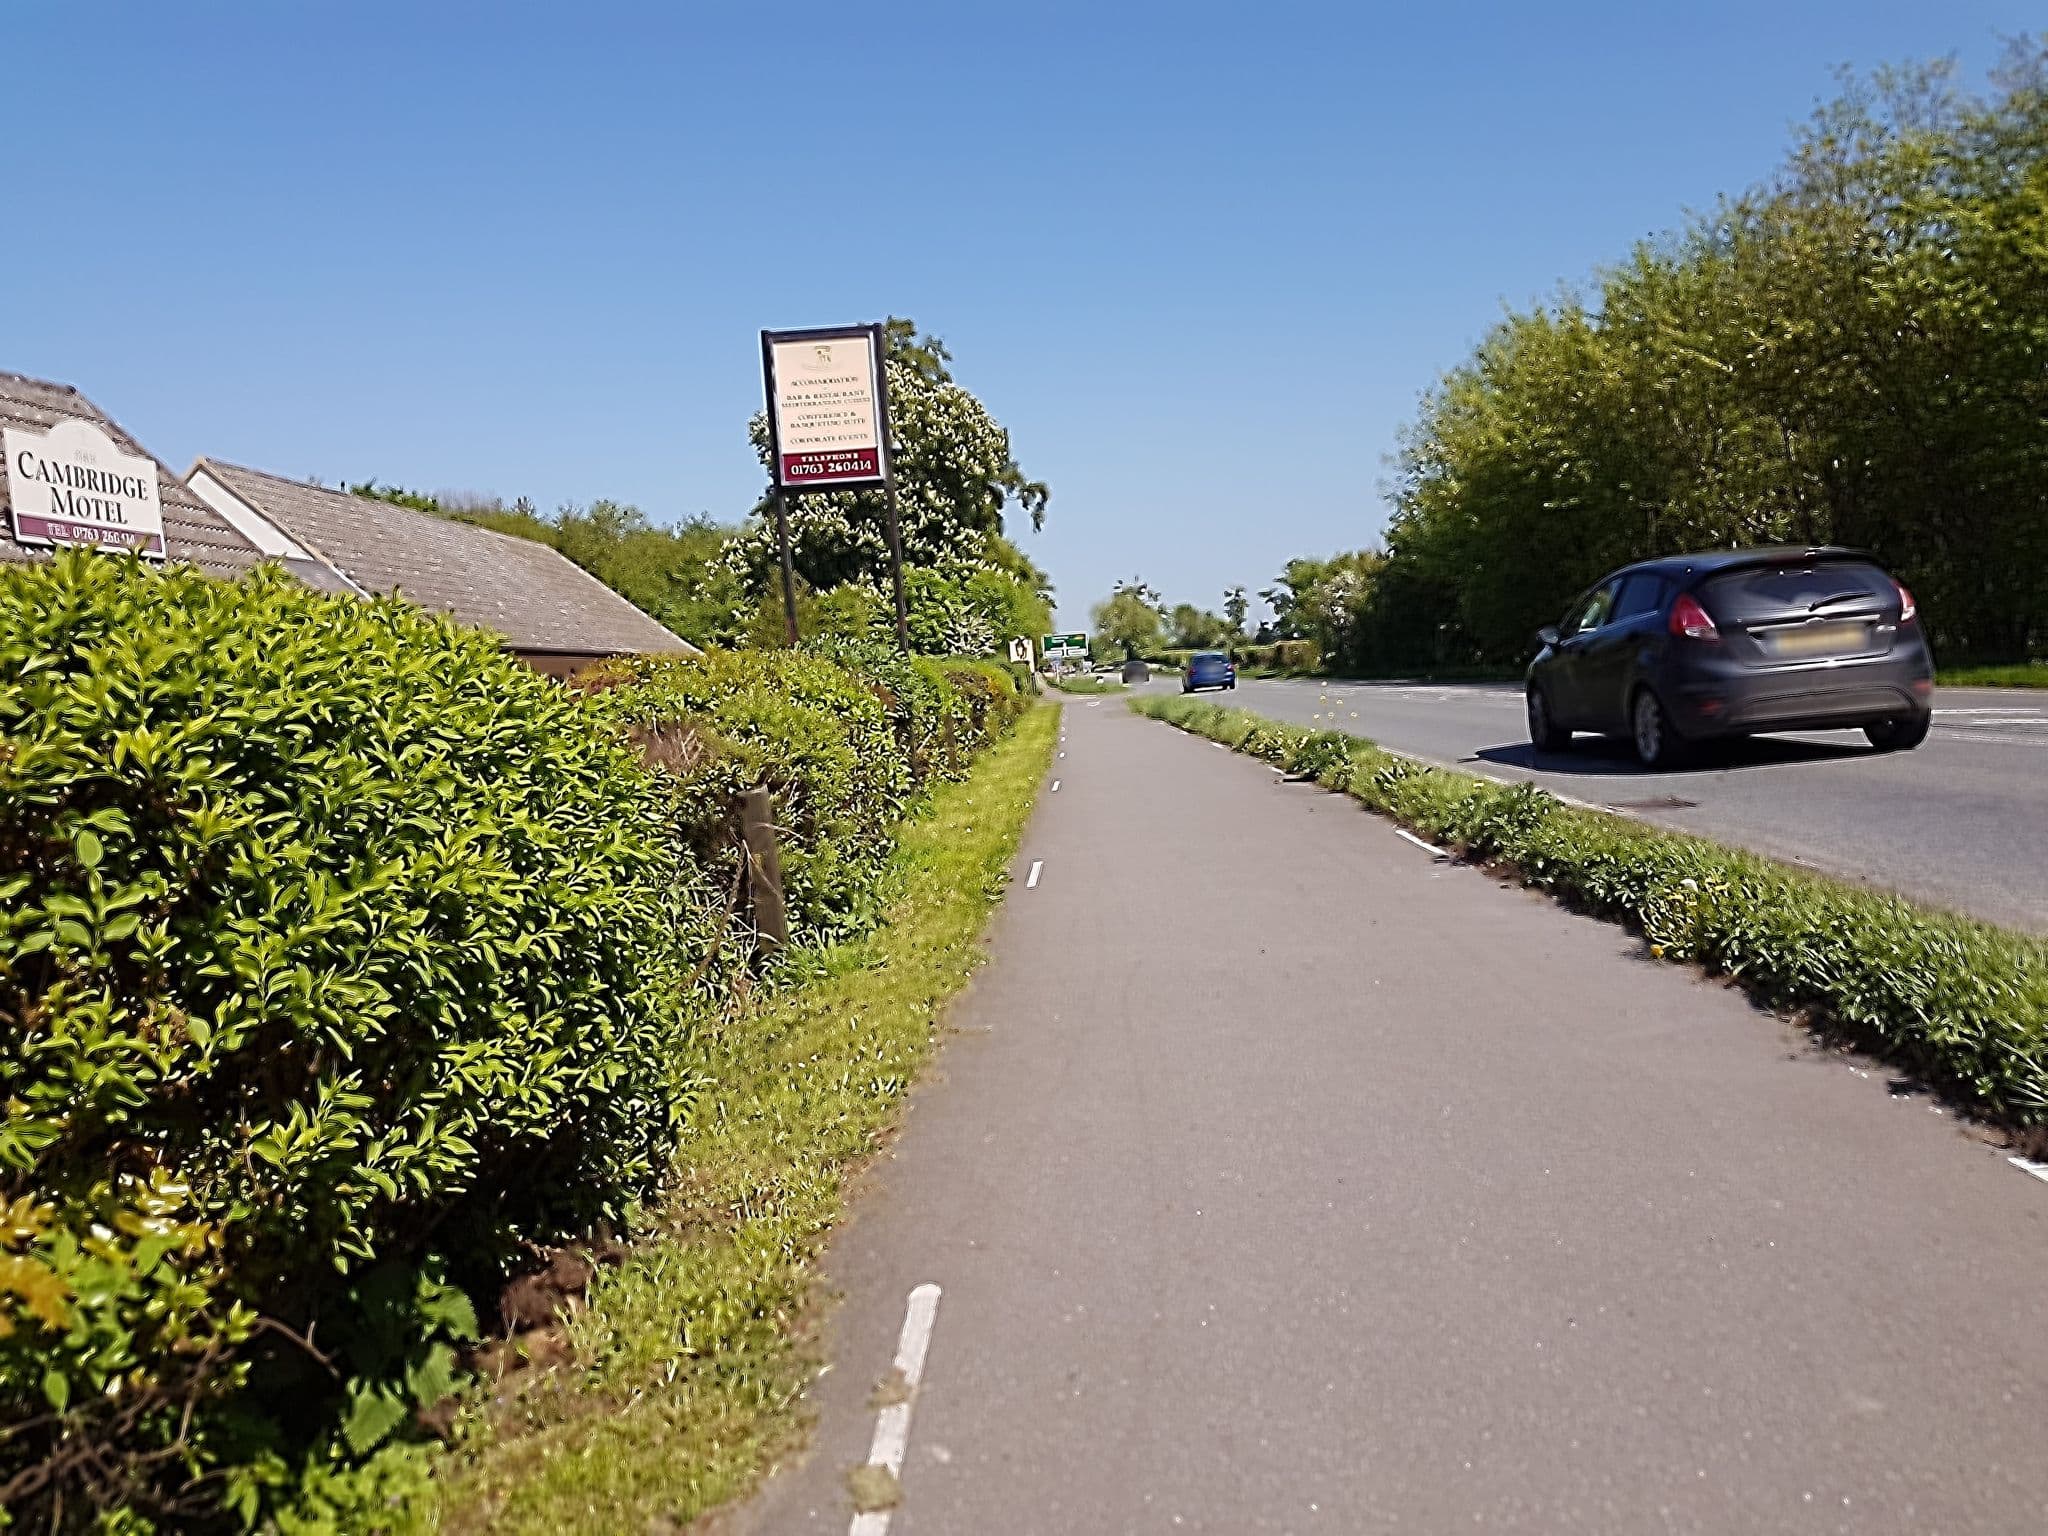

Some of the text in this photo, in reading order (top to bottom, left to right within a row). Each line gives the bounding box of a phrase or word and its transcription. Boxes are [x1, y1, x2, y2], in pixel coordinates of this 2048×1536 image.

[791, 461, 871, 475] 01763 260414
[801, 453, 858, 462] TELEPHONE
[17, 450, 149, 501] CAMBRIDGE
[50, 486, 128, 525] MOTEL
